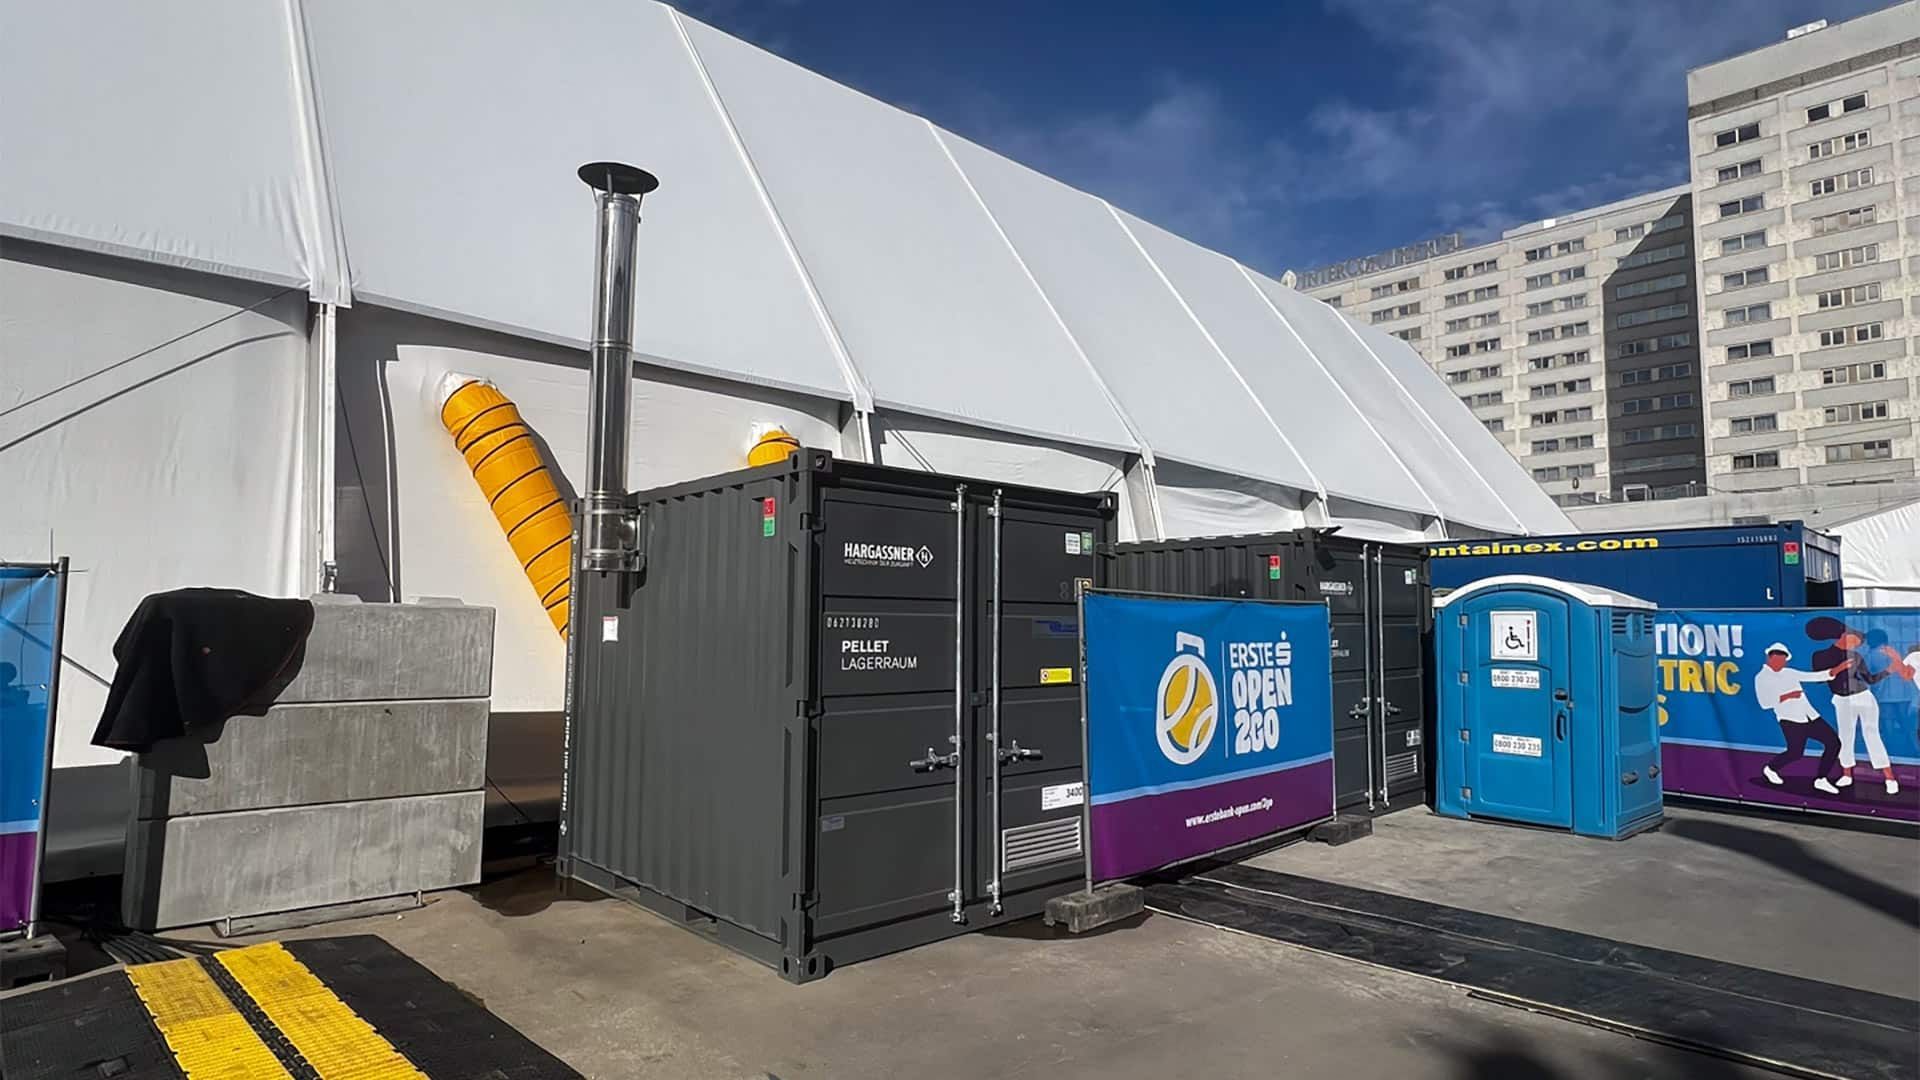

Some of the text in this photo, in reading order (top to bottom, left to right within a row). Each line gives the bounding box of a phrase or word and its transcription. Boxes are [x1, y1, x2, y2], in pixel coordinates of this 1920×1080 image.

[844, 542, 914, 561] HARGASSNER
[1766, 587, 1775, 600] L
[842, 640, 889, 653] PELLET
[1229, 642, 1275, 668] ERSTE
[841, 656, 917, 671] LAGERRAUM
[1658, 659, 1741, 695] TRIC
[1232, 667, 1293, 713] OPEN
[1234, 708, 1280, 755] 2GO
